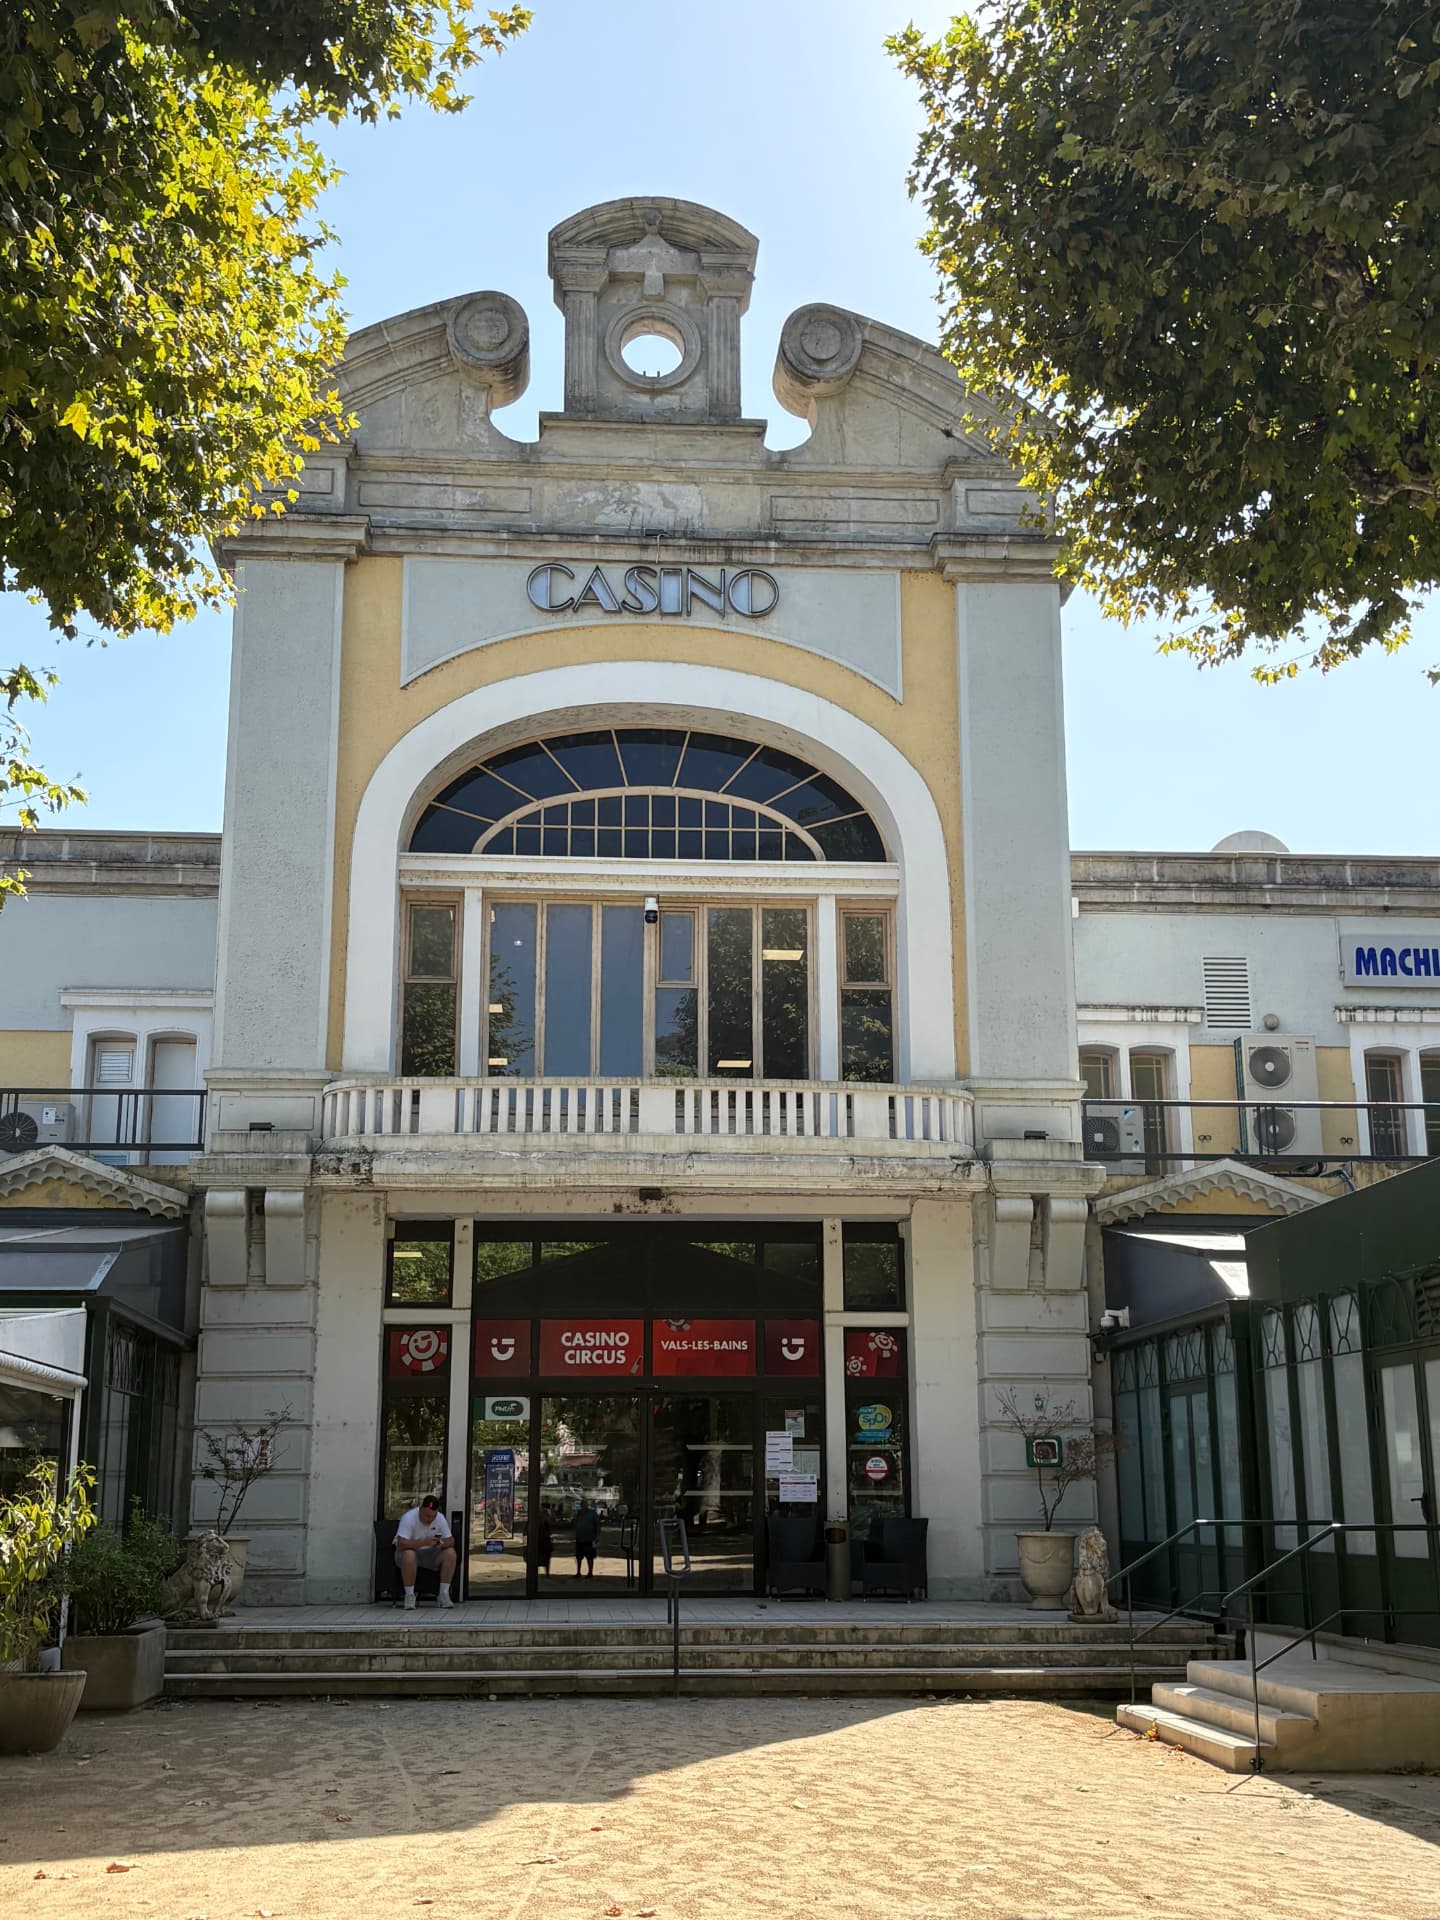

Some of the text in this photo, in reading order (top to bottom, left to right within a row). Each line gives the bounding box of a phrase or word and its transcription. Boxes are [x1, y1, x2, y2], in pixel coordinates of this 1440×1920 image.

[526, 562, 779, 618] CASINO
[560, 1331, 630, 1347] CASINO
[661, 1340, 749, 1350] VALS-LES-BAINS
[564, 1349, 626, 1364] CIRCUS
